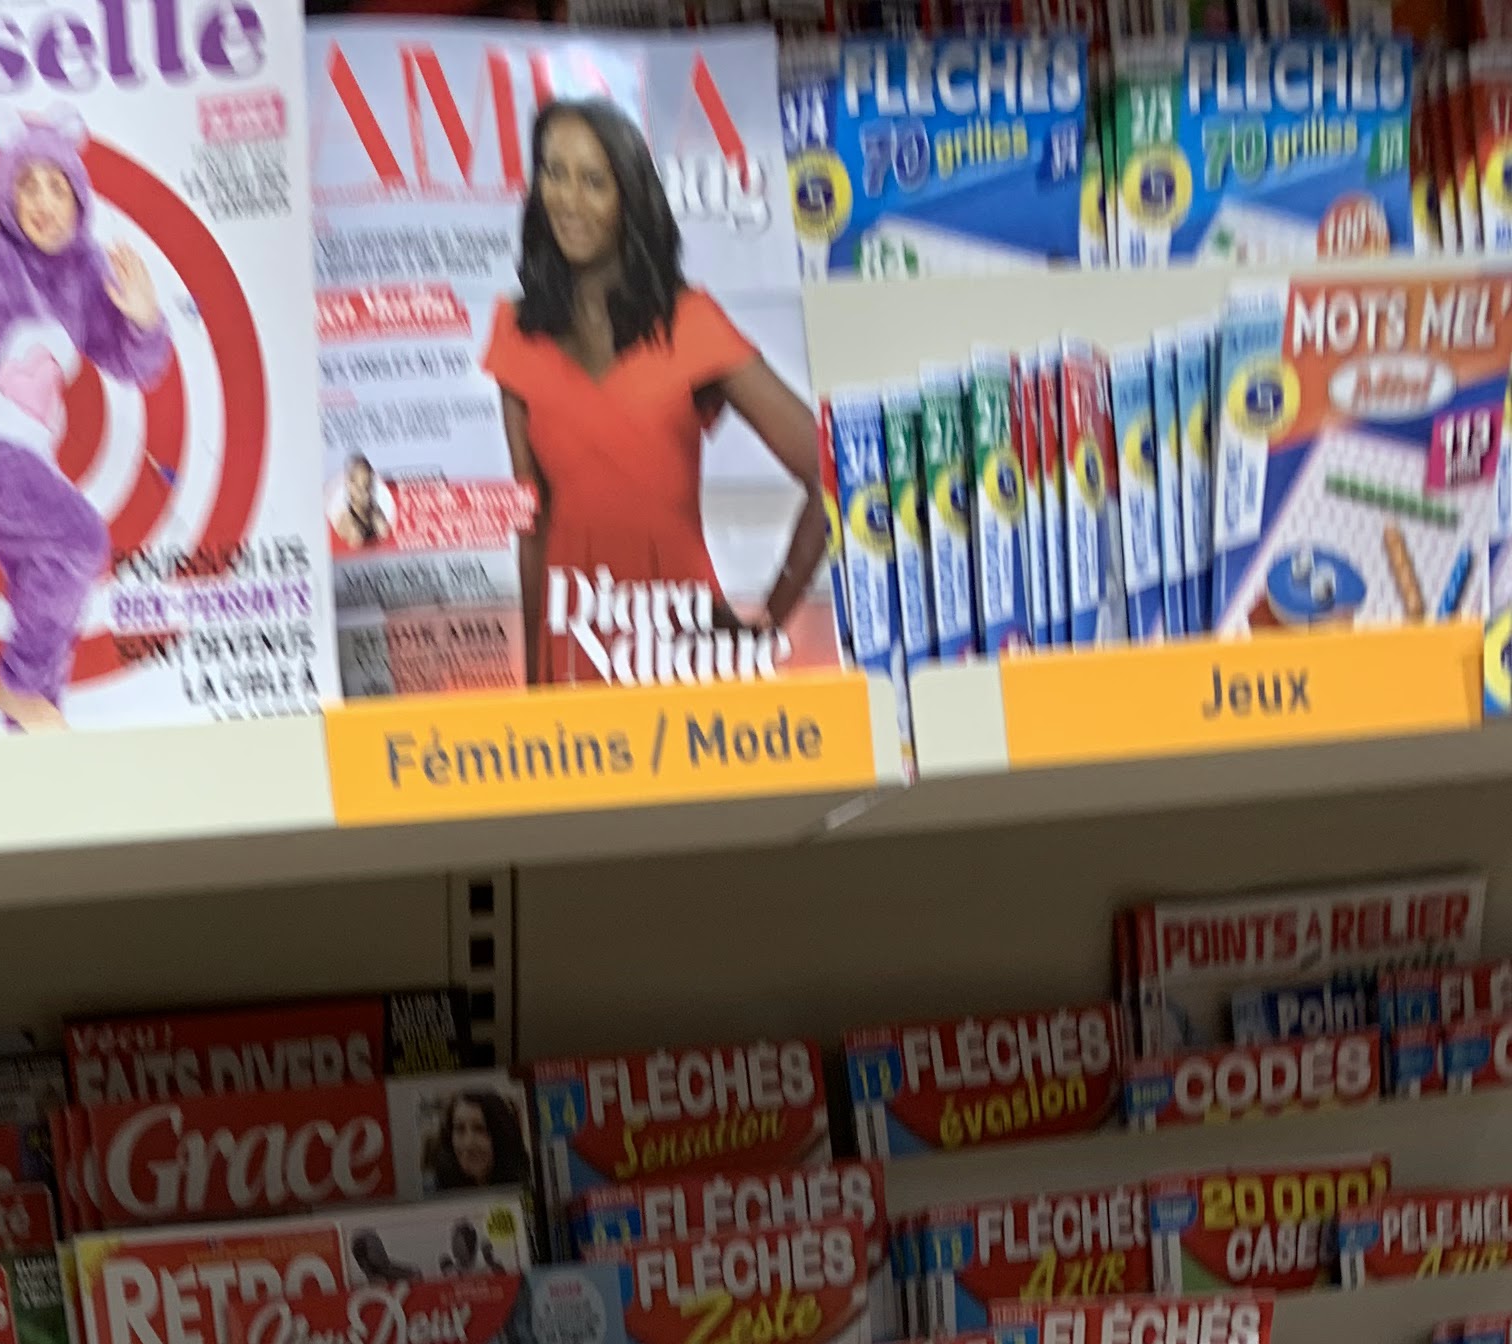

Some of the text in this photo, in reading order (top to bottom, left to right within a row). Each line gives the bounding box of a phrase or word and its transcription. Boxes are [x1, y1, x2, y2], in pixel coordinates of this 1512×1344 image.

[1202, 665, 1312, 719] Jeux
[385, 708, 823, 789] Féminins / Mode
[106, 1103, 385, 1220] Grace
